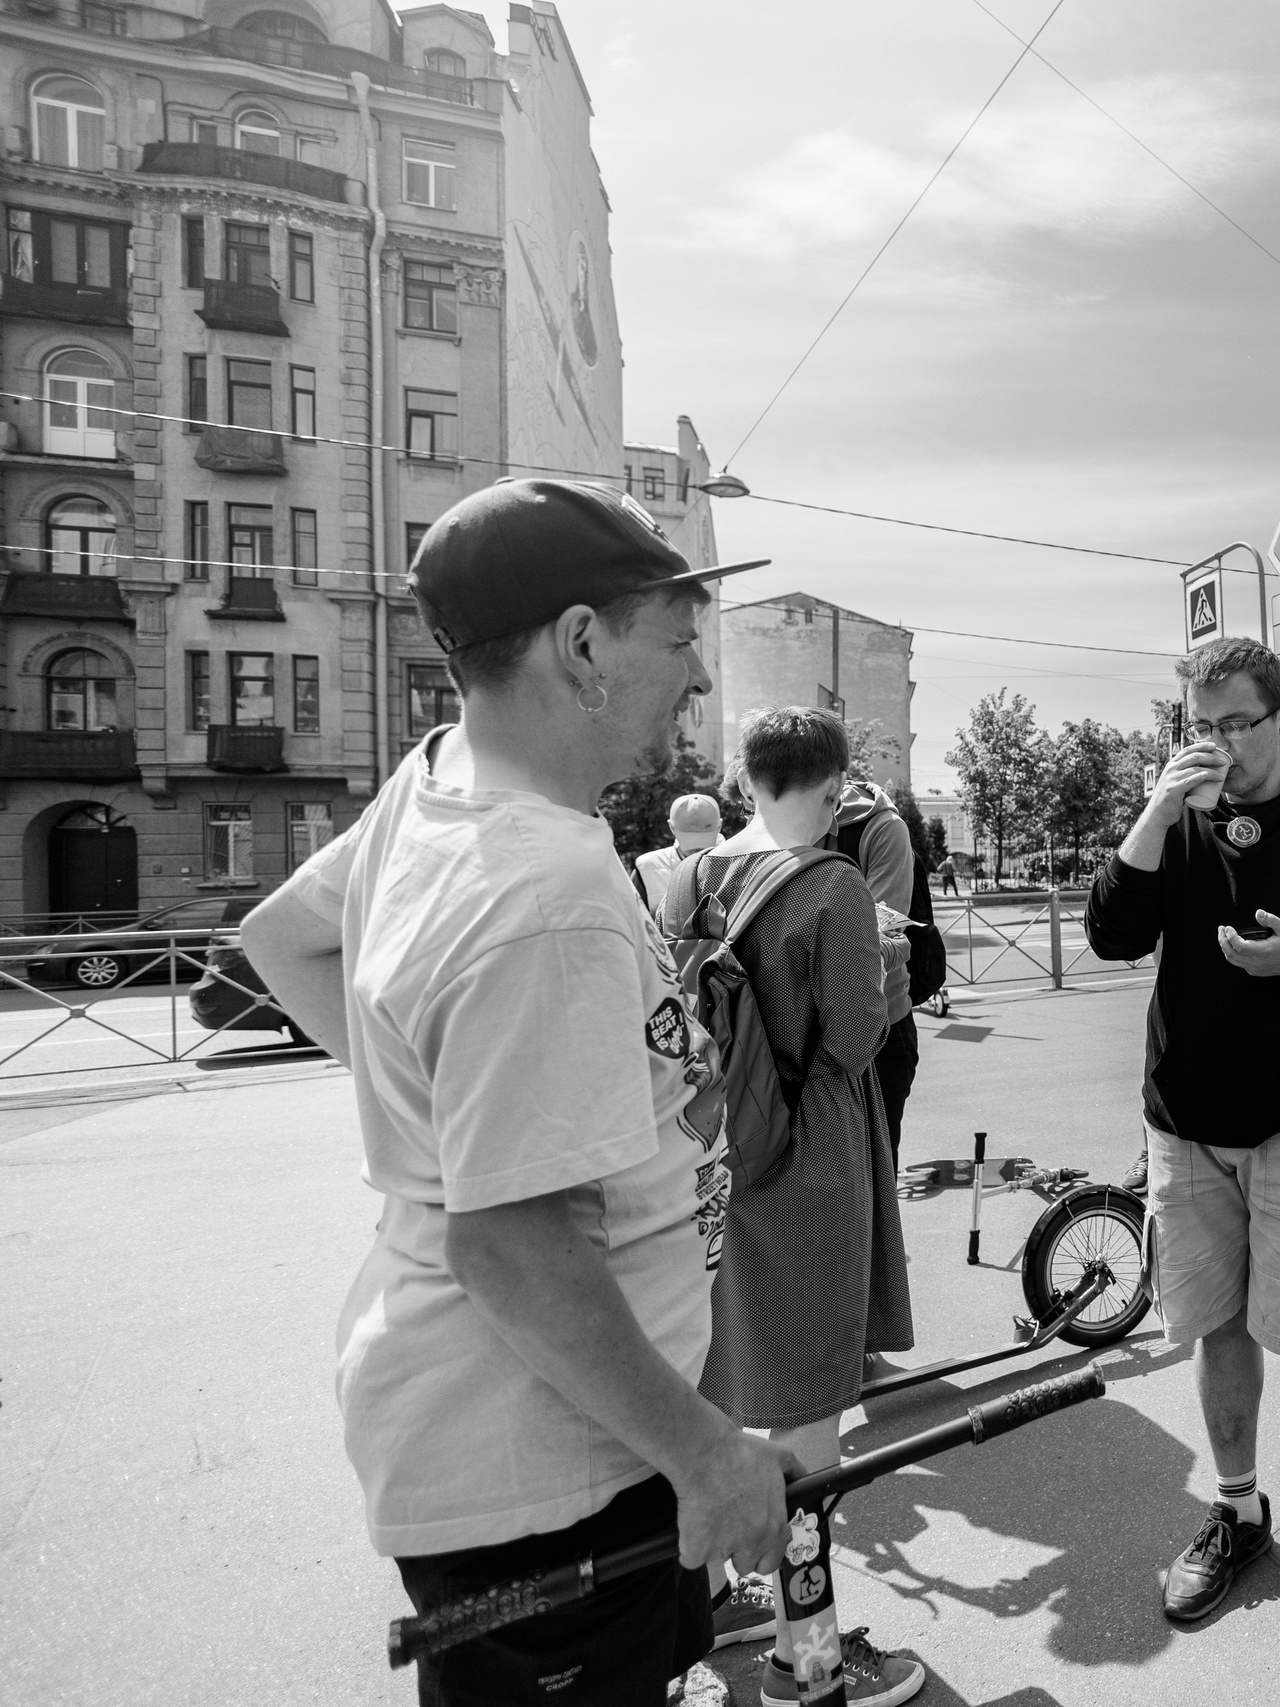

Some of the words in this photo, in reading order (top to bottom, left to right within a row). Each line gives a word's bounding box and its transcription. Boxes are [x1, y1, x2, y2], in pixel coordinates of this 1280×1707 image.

[648, 1006, 673, 1029] THIS
[651, 1014, 677, 1041] BEAT
[656, 1037, 669, 1051] IS
[546, 1677, 574, 1691] CROPP
